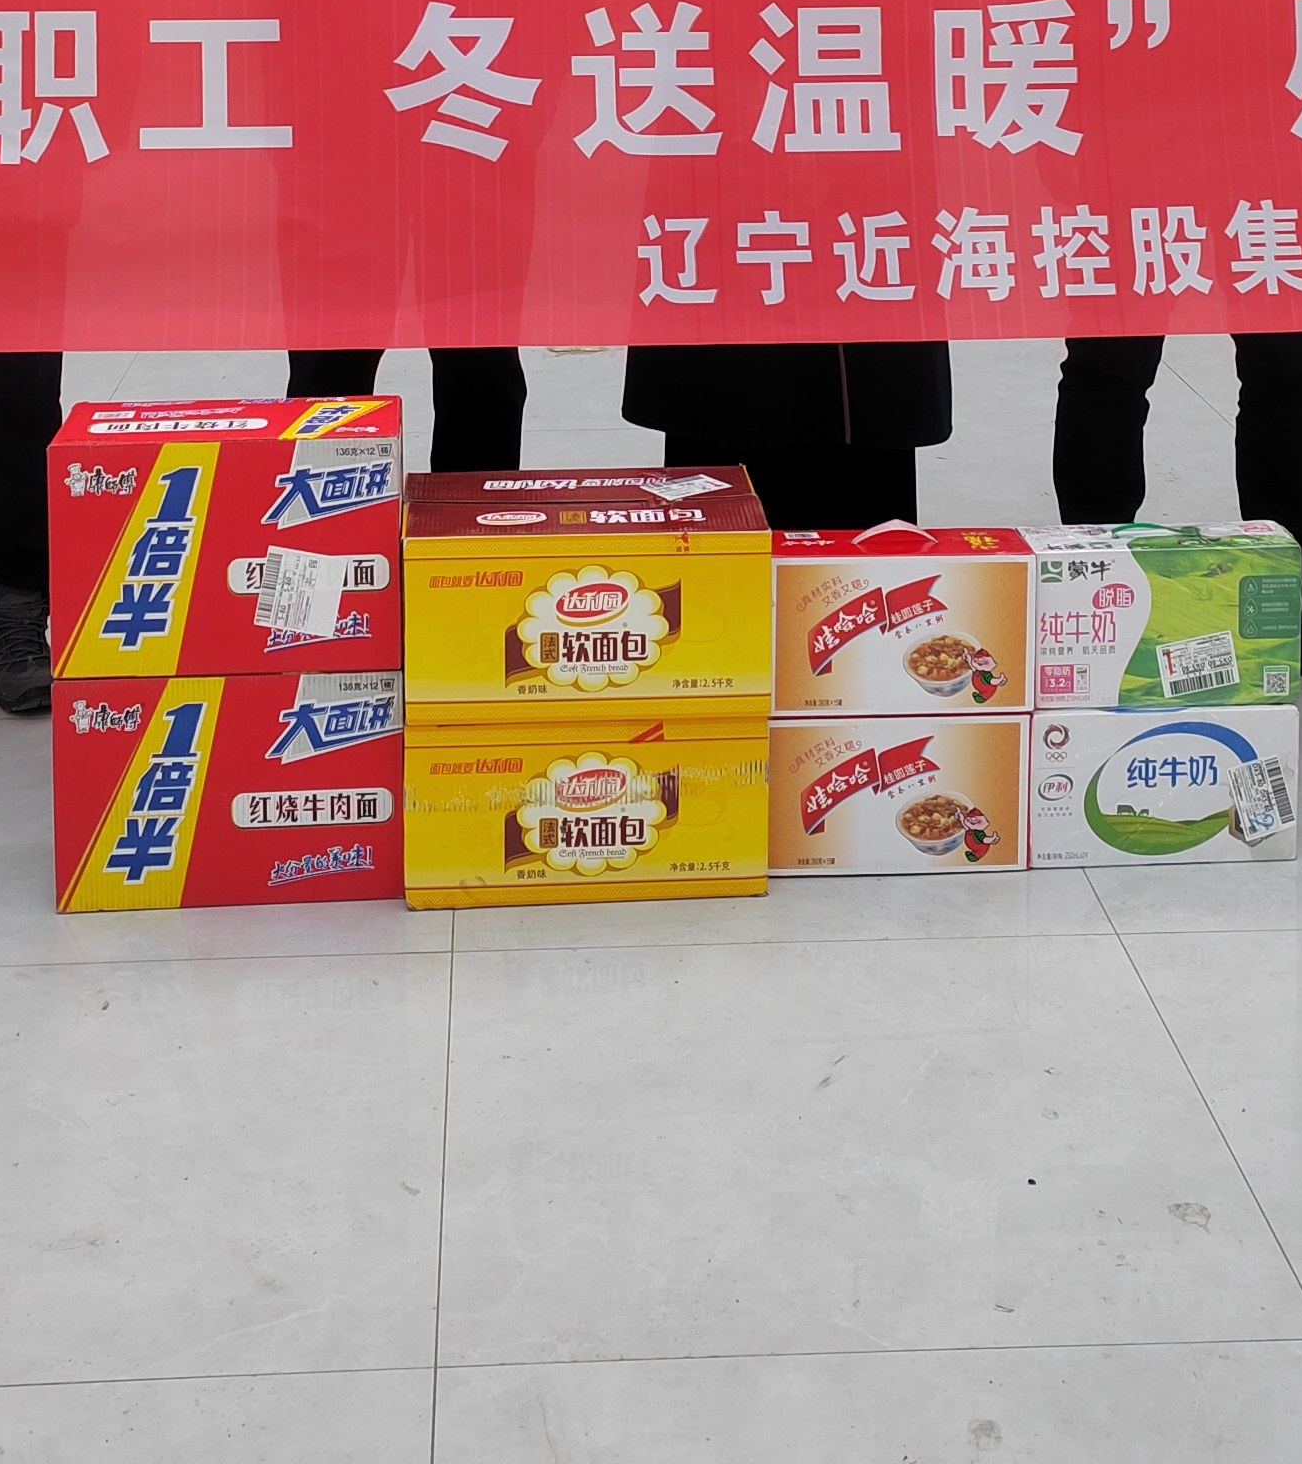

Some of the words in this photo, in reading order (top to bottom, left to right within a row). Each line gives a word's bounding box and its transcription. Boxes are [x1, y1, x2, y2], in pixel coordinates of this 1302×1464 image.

[262, 461, 395, 525] 大面饼
[101, 466, 201, 650] 1倍半
[1067, 559, 1112, 582] 蒙牛
[562, 589, 623, 613] 达利园
[1099, 587, 1133, 608] 脱脂
[813, 601, 879, 654] 娃哈哈
[1040, 611, 1117, 645] 纯牛奶
[562, 631, 649, 663] 软面包
[266, 695, 398, 761] 大面饼
[806, 762, 871, 814] 娃哈哈
[1042, 781, 1069, 794] 伊利
[1126, 755, 1218, 789] 纯牛奶
[106, 702, 206, 884] 1倍半
[249, 793, 377, 823] 红烧牛肉面
[560, 816, 647, 848] 软面包
